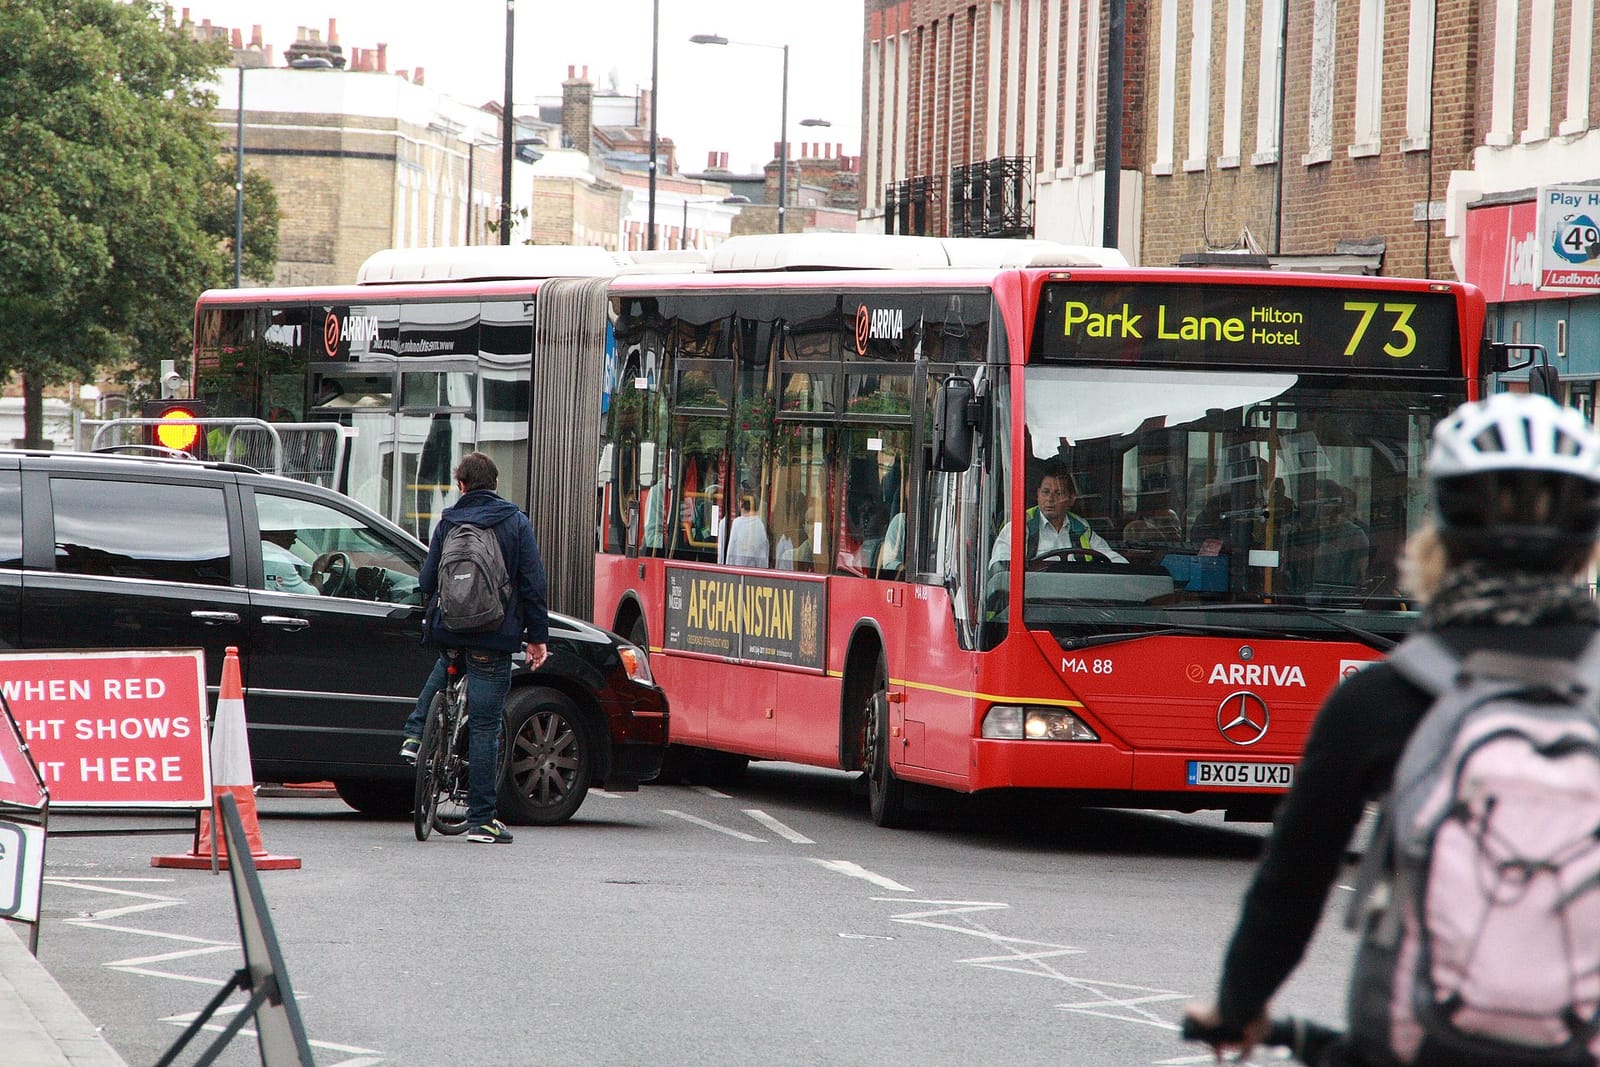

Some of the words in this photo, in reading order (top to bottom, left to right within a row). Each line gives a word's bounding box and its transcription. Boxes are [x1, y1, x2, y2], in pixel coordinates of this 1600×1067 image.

[1550, 192, 1582, 207] Play
[869, 308, 904, 339] ARRIVA
[1064, 301, 1143, 339] Park
[1157, 305, 1245, 342] Lane
[1251, 306, 1303, 324] Hilton
[340, 315, 380, 342] ARRIVA
[1251, 328, 1301, 345] Hotel
[1343, 301, 1417, 358] 73
[687, 578, 794, 641] AFGHANISTAN
[1062, 657, 1088, 673] MA
[1093, 659, 1113, 674] 88
[1208, 663, 1307, 687] ARRIVA
[0, 679, 91, 701] WHEN
[103, 678, 167, 700] RED
[75, 717, 191, 740] SHOWS
[79, 756, 183, 782] HERE
[1200, 764, 1249, 782] BX05
[1254, 766, 1290, 784] UXD
